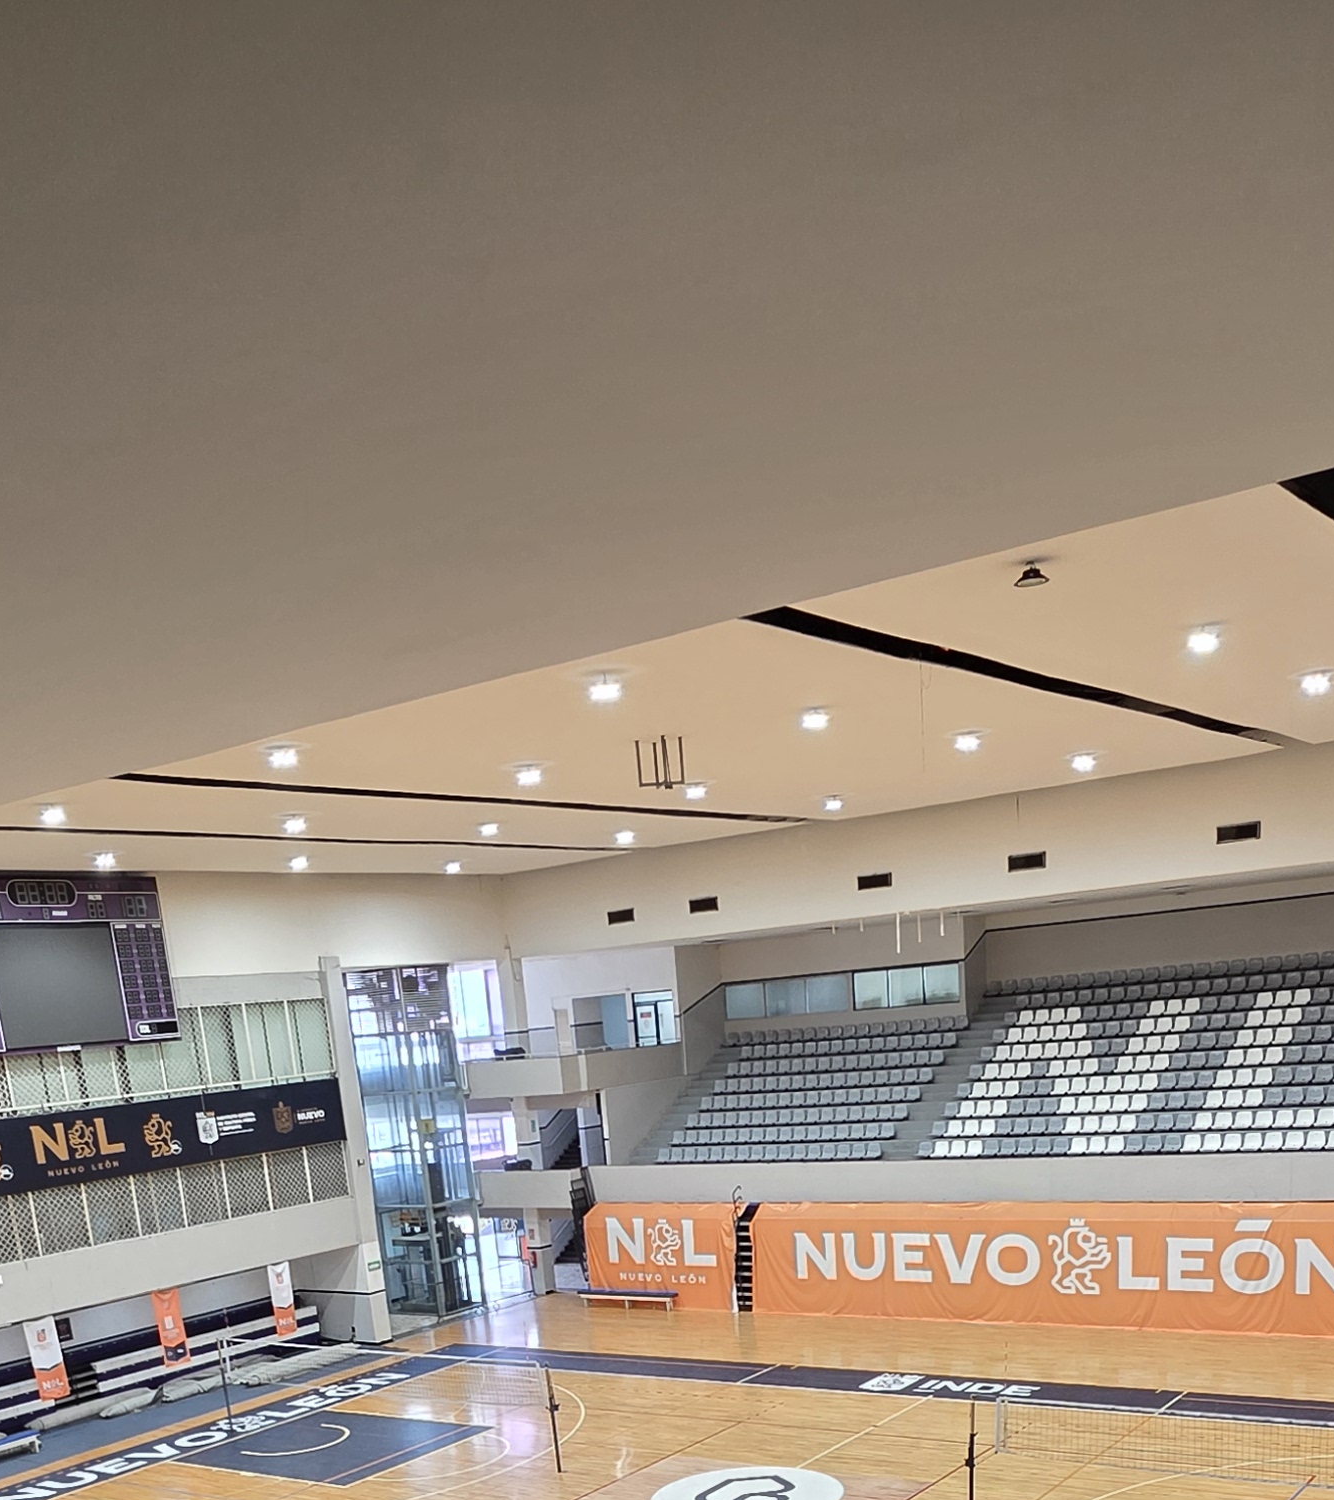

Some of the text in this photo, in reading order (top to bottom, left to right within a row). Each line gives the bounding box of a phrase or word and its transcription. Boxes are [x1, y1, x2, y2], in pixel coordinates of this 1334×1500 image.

[47, 1160, 120, 1178] NUEVO LEÓN
[793, 1231, 1041, 1286] NUEVO
[619, 1269, 706, 1285] NUEVO LEÓN
[259, 1372, 411, 1419] LEÓN
[914, 1379, 1042, 1397] INDE
